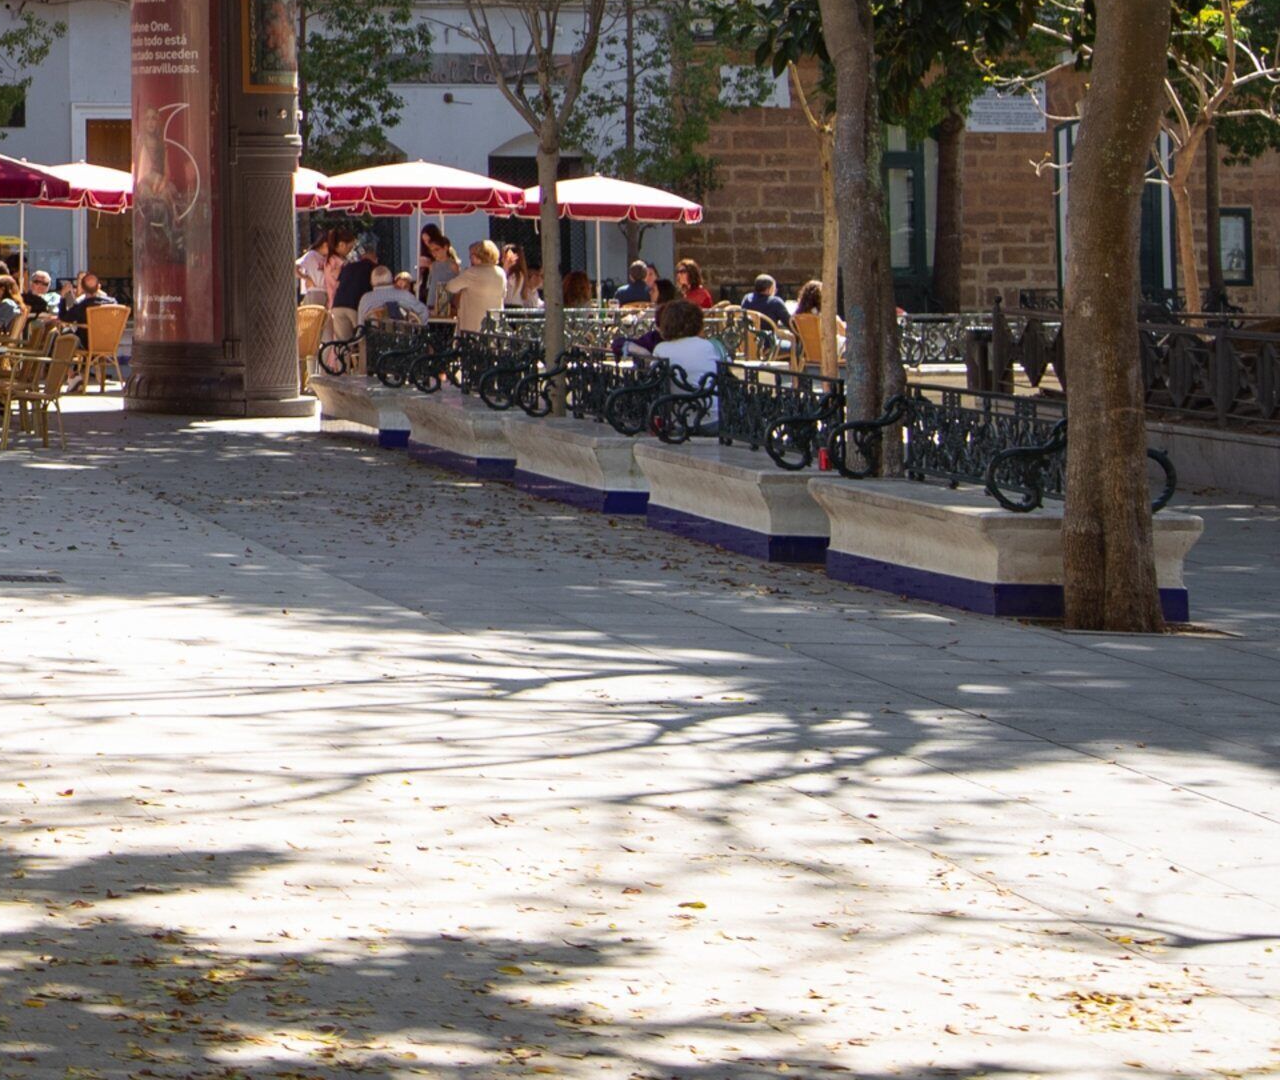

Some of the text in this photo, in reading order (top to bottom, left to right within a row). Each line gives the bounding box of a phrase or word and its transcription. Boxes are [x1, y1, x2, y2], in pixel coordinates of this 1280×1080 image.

[151, 21, 172, 32] One.
[144, 35, 163, 46] todo
[164, 33, 187, 46] está
[155, 48, 198, 60] suceden
[140, 63, 199, 74] maravillosas.
